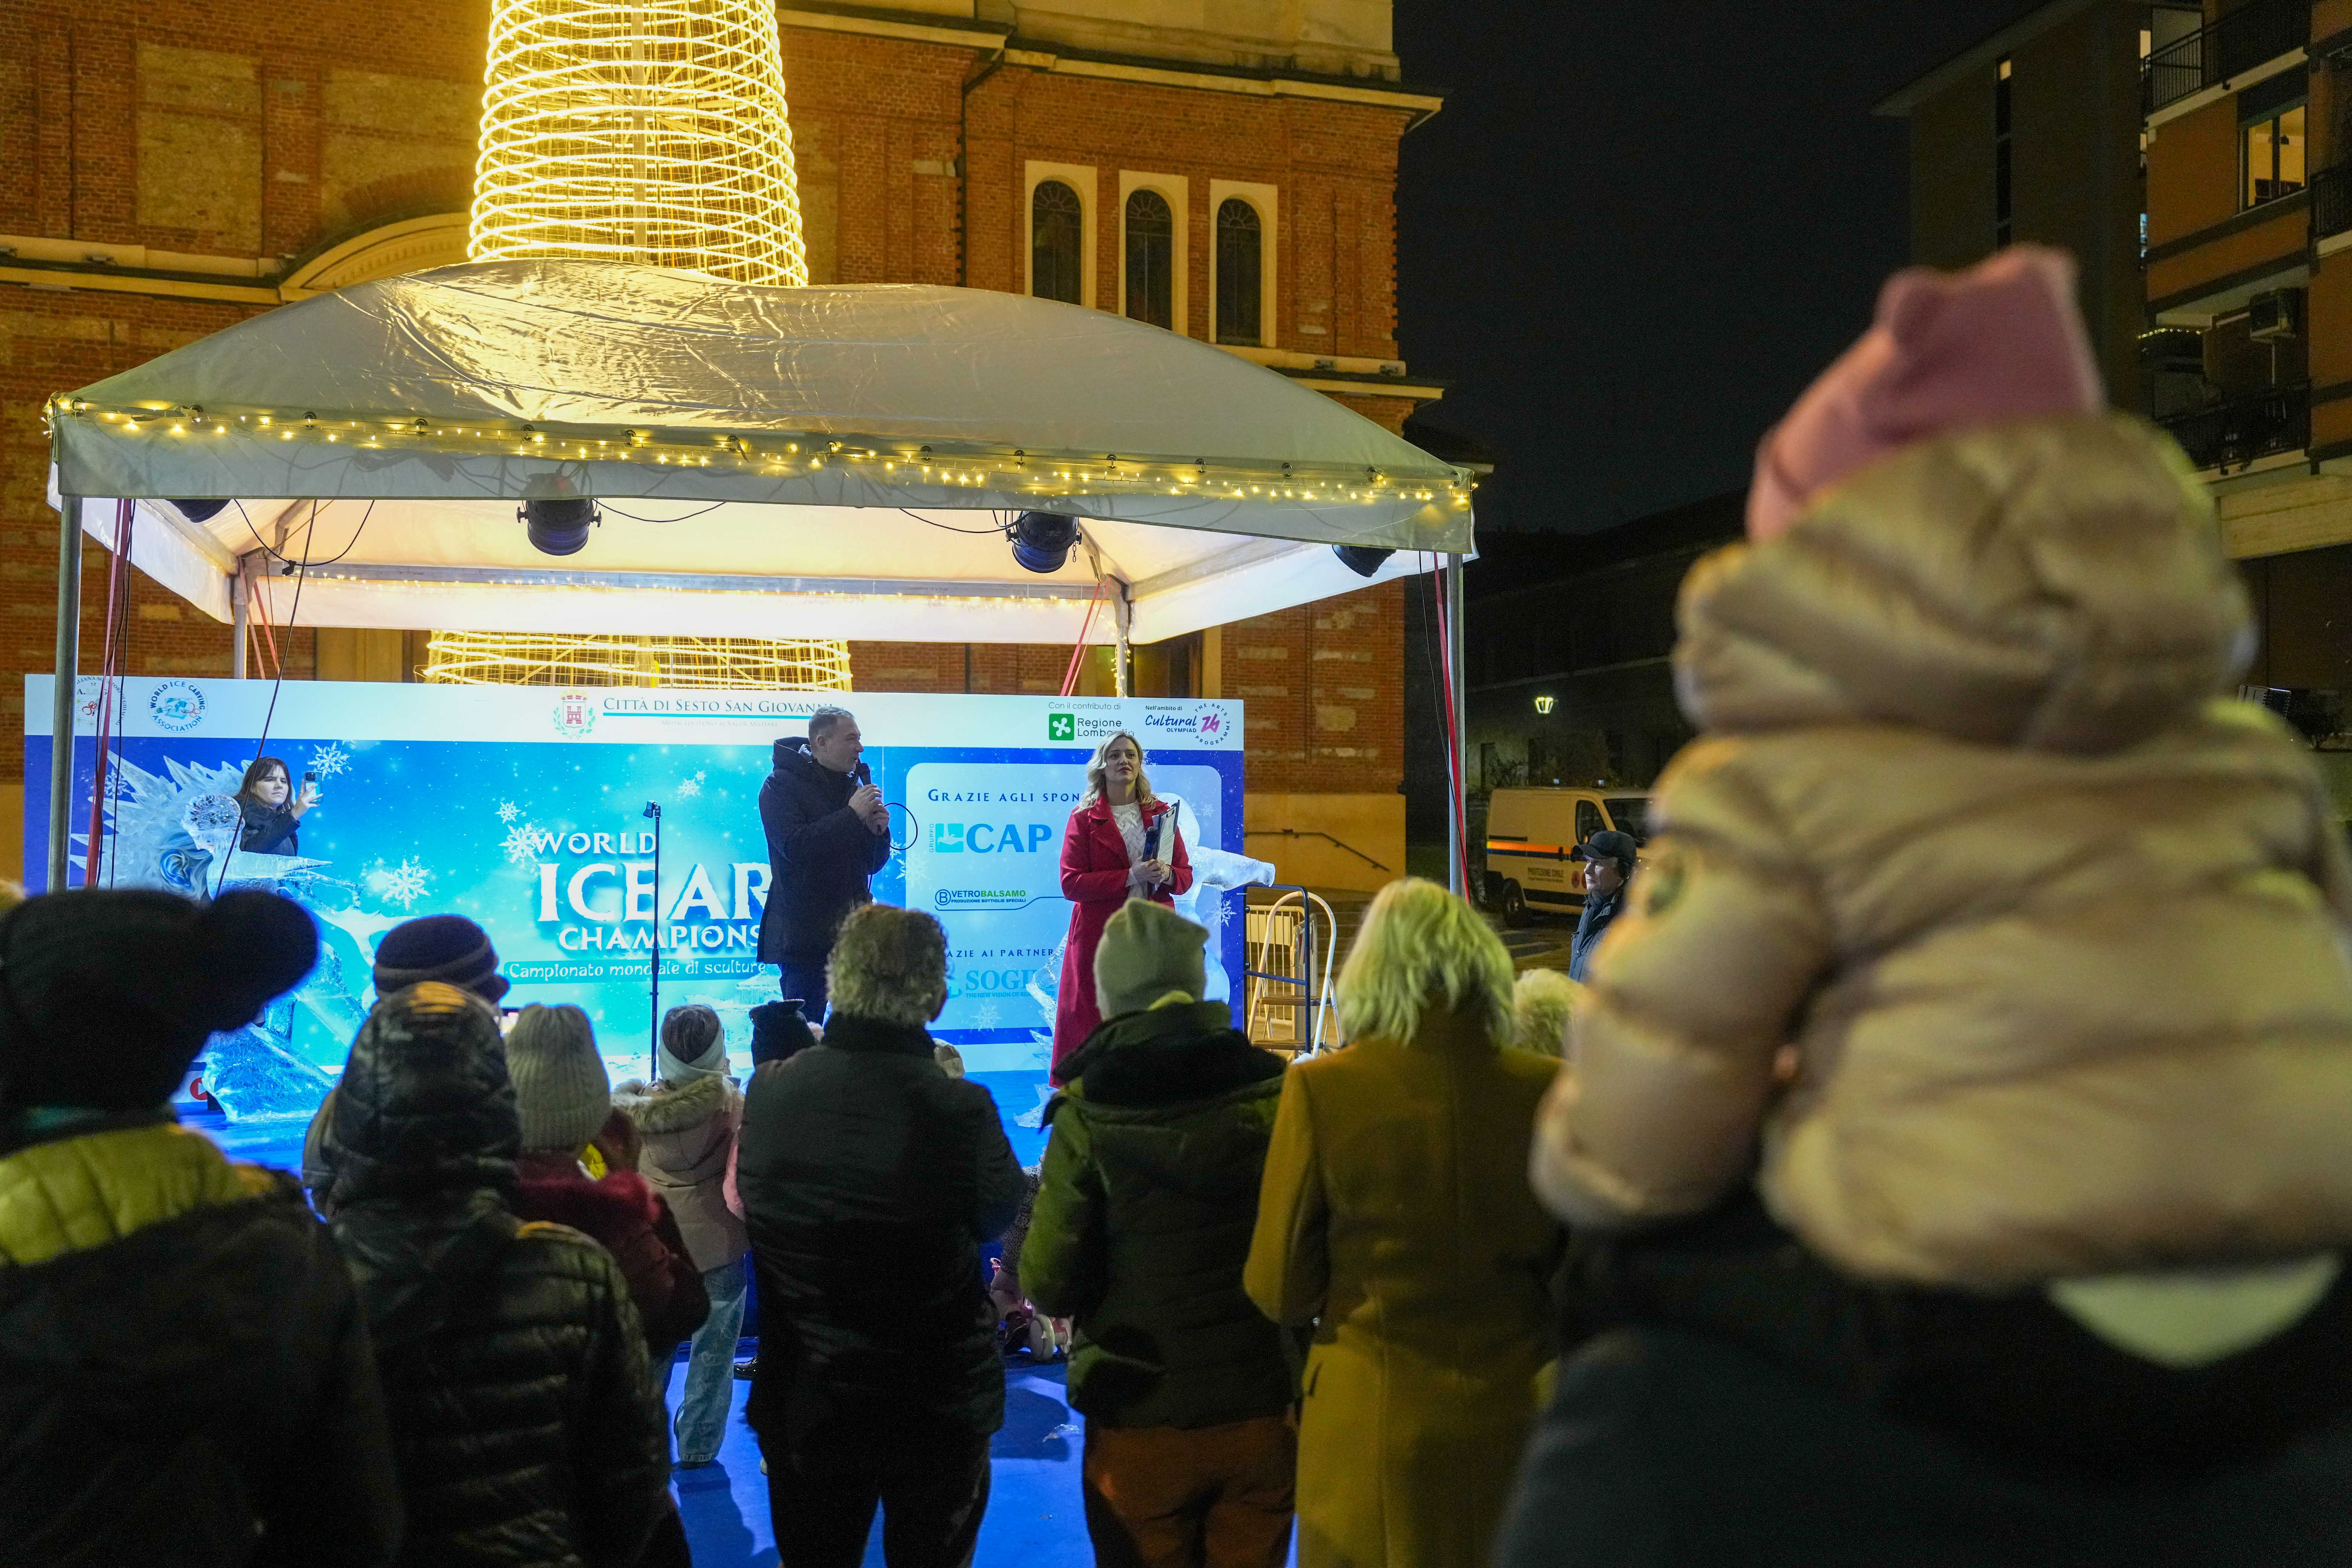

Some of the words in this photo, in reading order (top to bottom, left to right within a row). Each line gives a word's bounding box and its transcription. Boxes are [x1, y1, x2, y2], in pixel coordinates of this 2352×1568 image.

[150, 684, 168, 709] WORLD
[188, 685, 205, 710] CARVING
[604, 697, 648, 710] CITTÀ
[654, 700, 669, 710] DI
[676, 699, 720, 711] SESTO
[725, 700, 752, 712] SAN
[759, 701, 832, 713] GIOVAN
[1194, 703, 1207, 712] THE
[1145, 714, 1197, 726] Cultural
[1211, 703, 1228, 716] ARTS
[152, 715, 202, 731] ASSOCIATION
[1078, 718, 1122, 729] Regione
[1195, 720, 1230, 745] PROGRAMME
[928, 789, 990, 802] GRAZIE
[999, 793, 1034, 802] AGLI
[1043, 793, 1080, 802] SPON
[531, 832, 656, 854] WORLD
[966, 824, 1052, 853] CAP
[669, 862, 773, 920] AR
[559, 925, 760, 951] CHAMPIONS
[509, 963, 603, 981] Campionato
[609, 960, 680, 975] mondale
[685, 961, 699, 974] di
[704, 960, 766, 974] sculture
[966, 969, 1037, 991] SOGI
